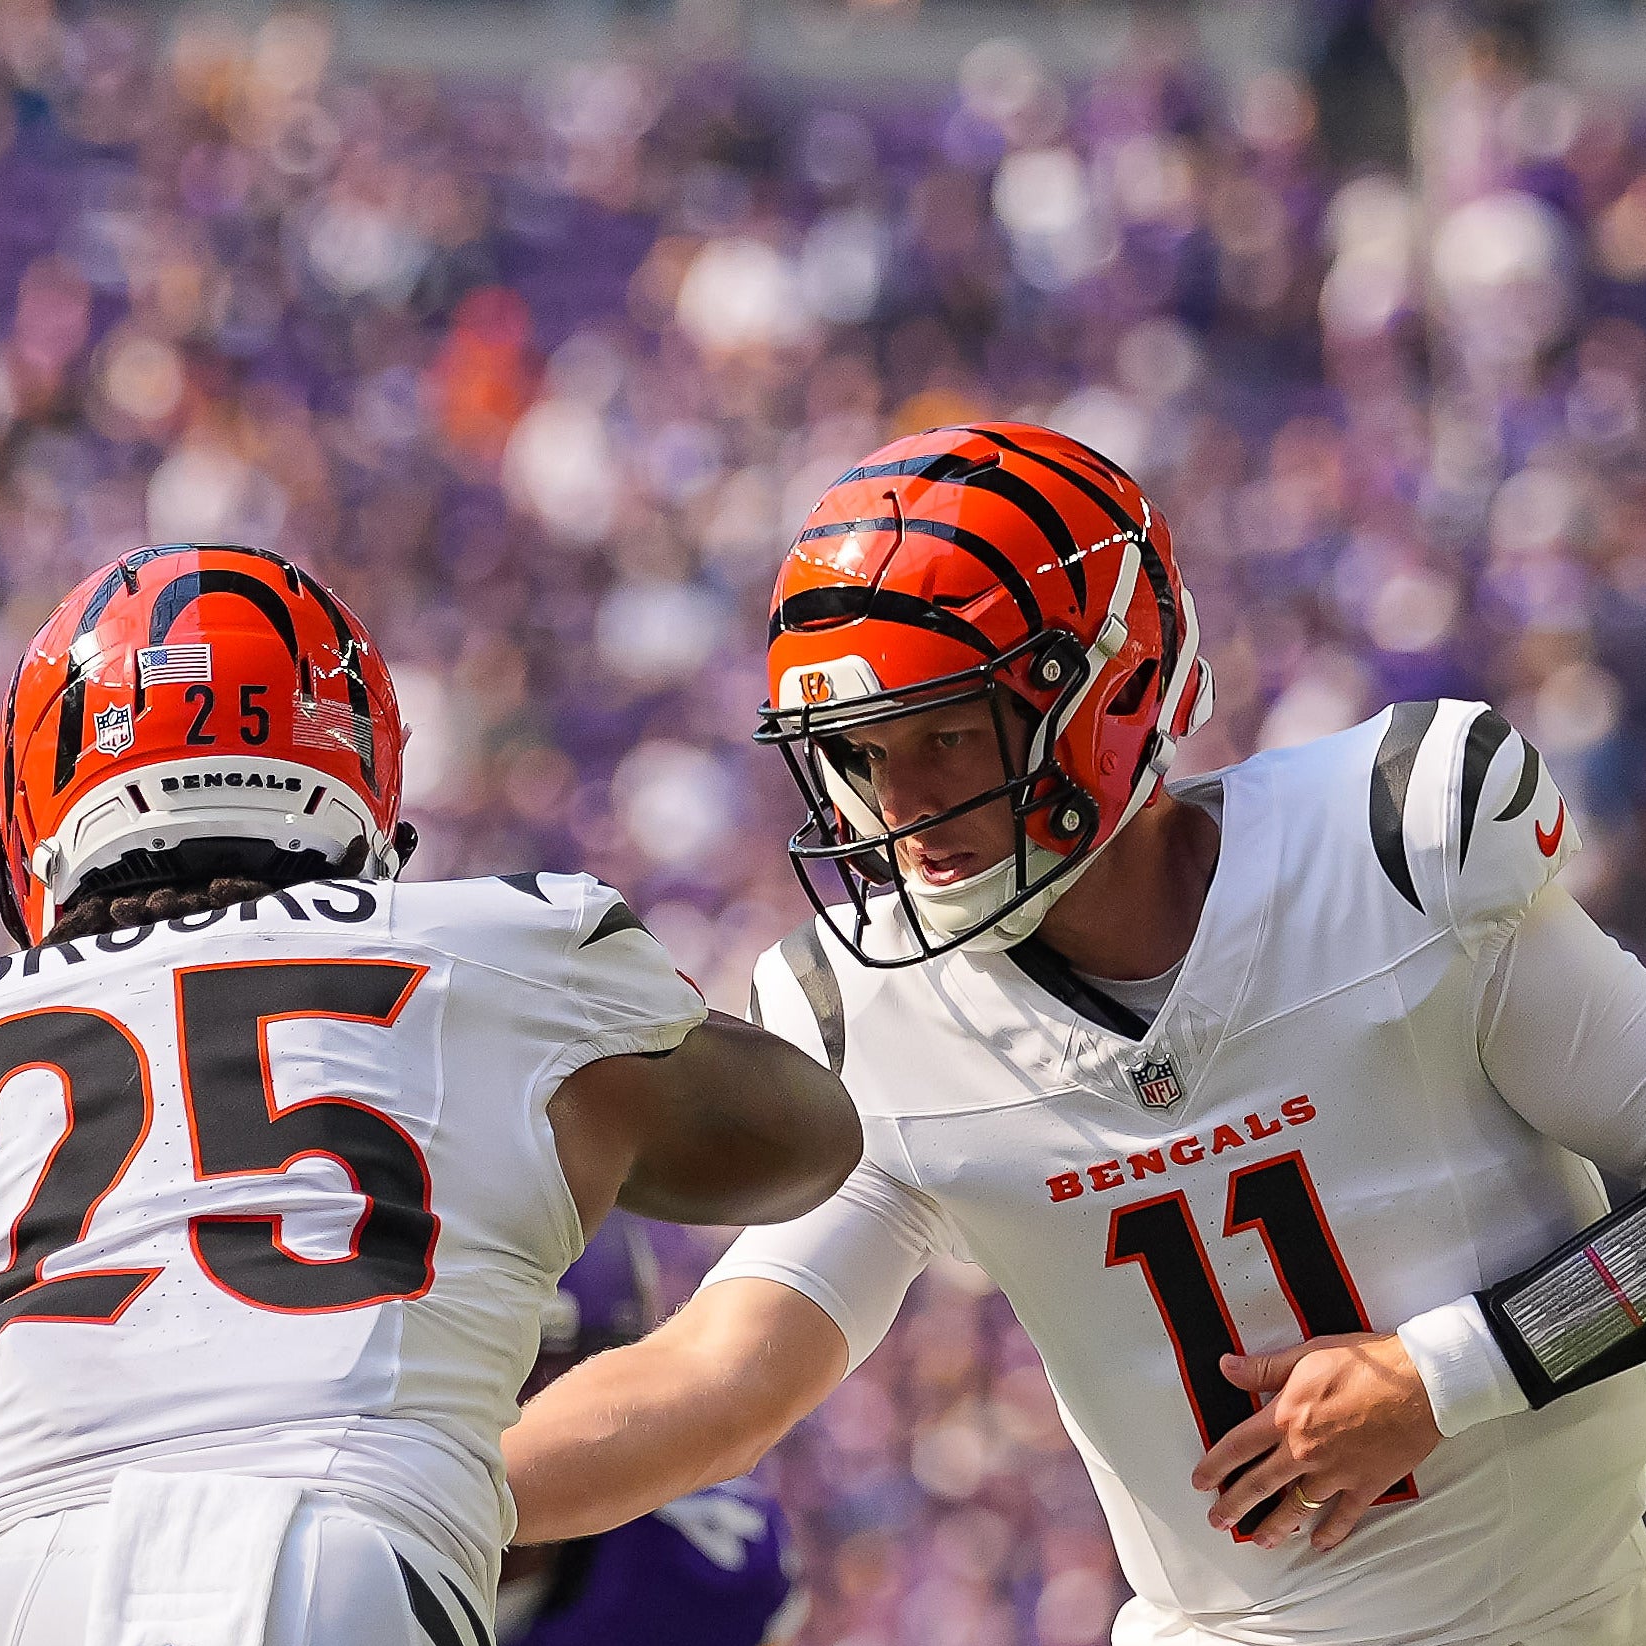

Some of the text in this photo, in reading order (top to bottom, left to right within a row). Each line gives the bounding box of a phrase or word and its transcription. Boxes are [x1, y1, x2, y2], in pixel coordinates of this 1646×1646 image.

[184, 684, 270, 746] 25
[161, 772, 302, 792] BENGALS
[1141, 1077, 1178, 1105] NFL
[1045, 1094, 1317, 1203] BENGALS
[1104, 1149, 1419, 1544] 11
